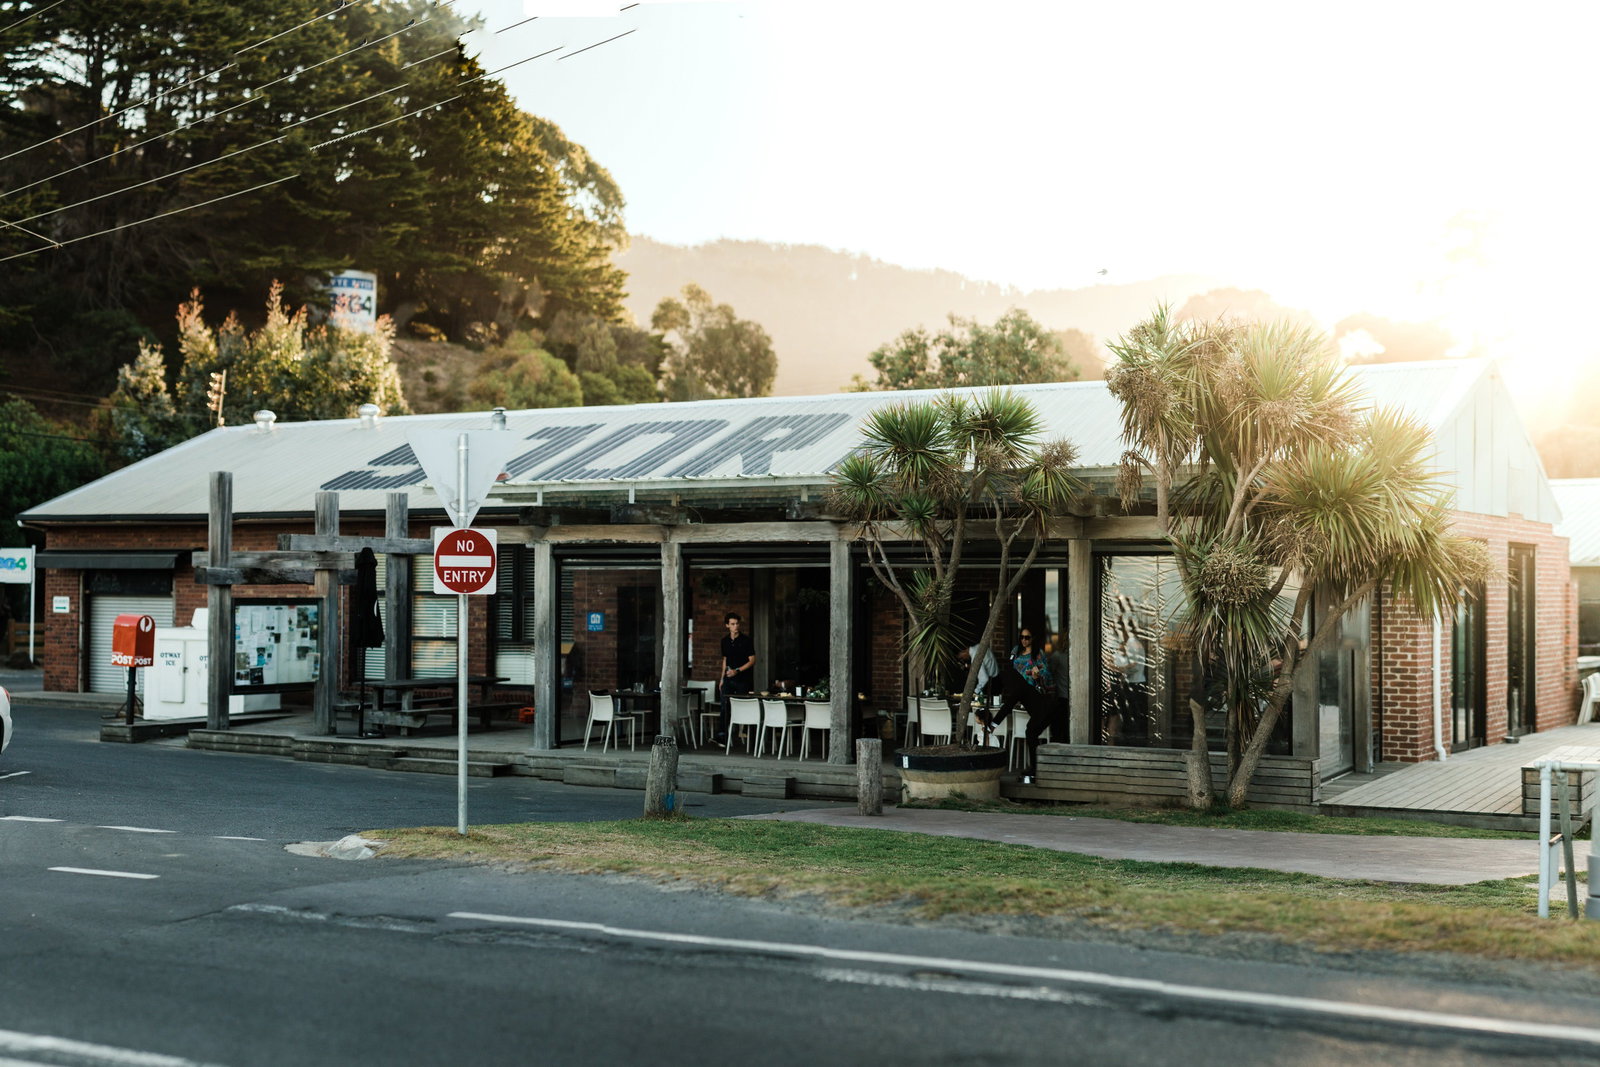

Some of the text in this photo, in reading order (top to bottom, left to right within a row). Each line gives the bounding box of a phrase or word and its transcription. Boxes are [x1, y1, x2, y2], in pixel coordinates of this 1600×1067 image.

[456, 540, 475, 553] NO
[443, 570, 487, 583] ENTRY
[111, 654, 133, 665] POST
[134, 657, 152, 665] POST
